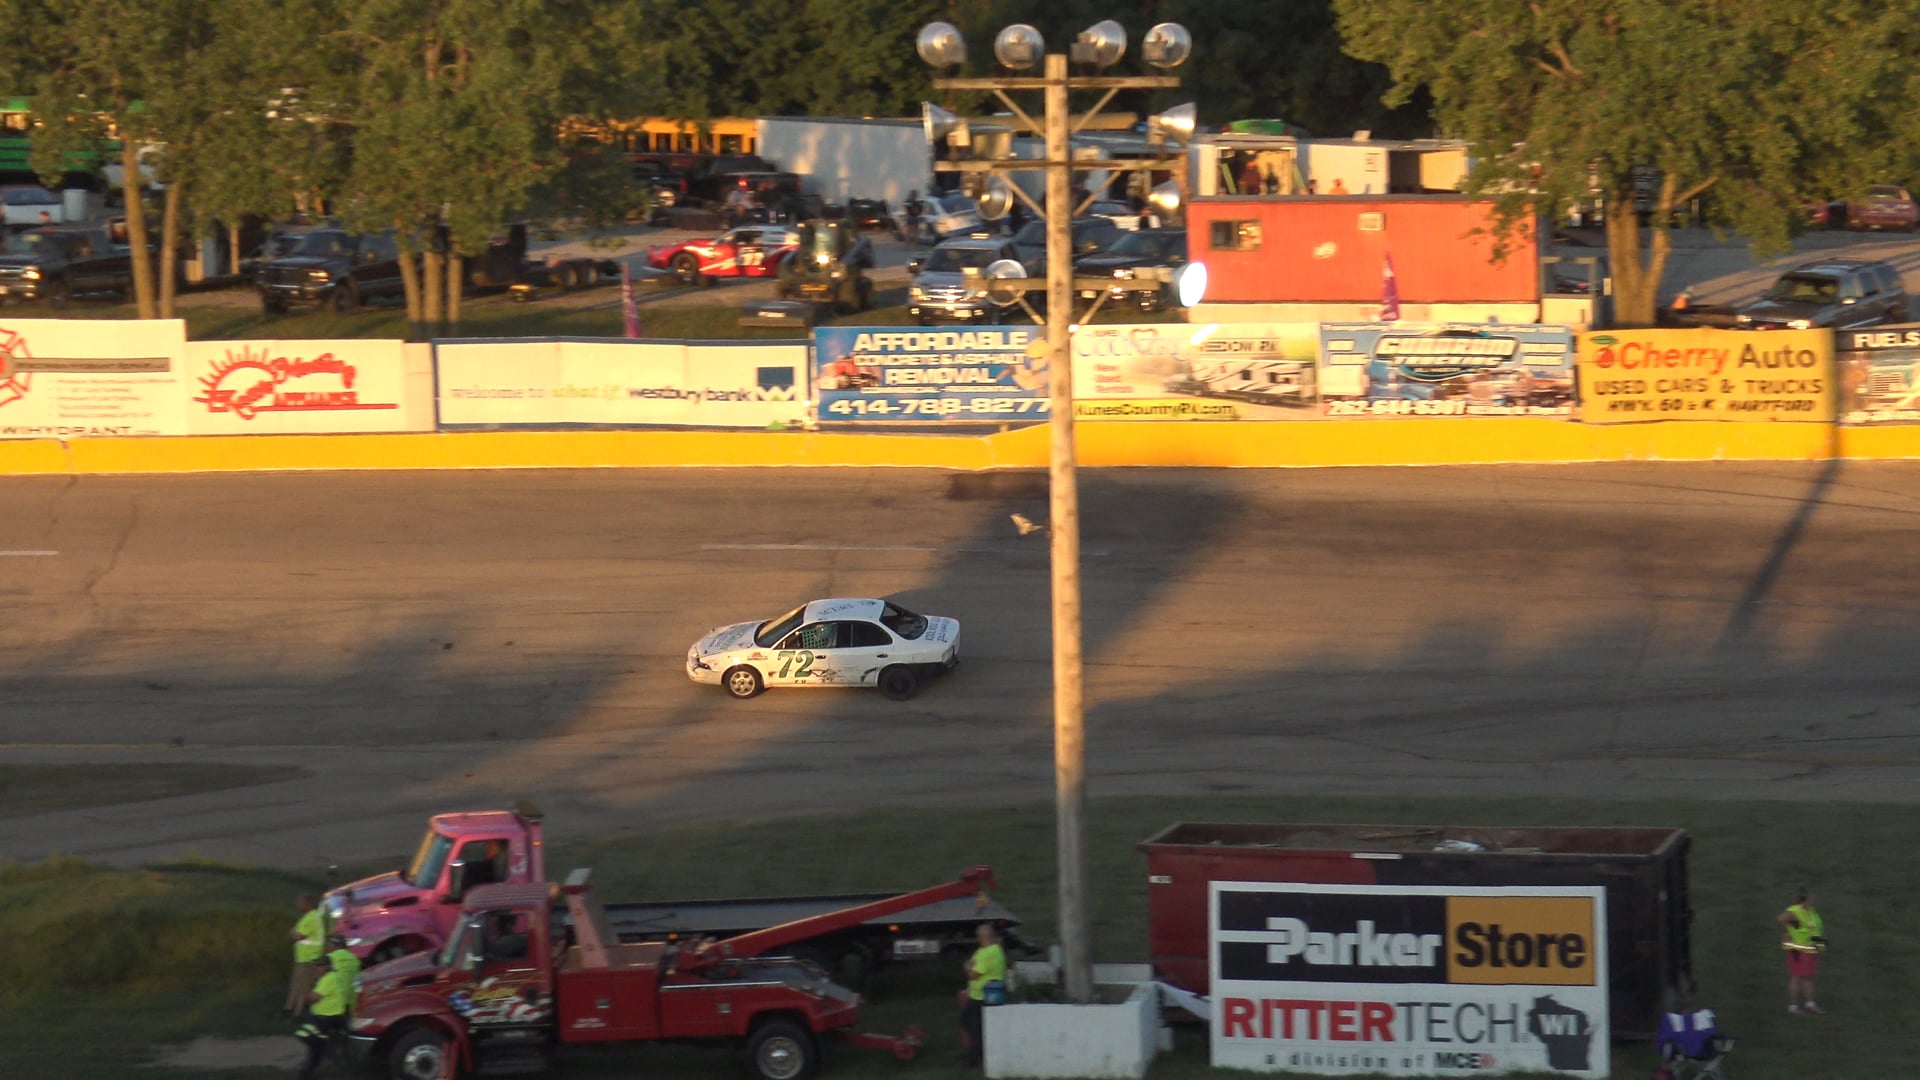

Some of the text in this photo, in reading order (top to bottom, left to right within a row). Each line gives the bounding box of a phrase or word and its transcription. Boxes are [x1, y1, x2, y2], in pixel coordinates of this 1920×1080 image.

[853, 332, 1029, 352] AFFORDABLE
[854, 354, 939, 366] CONCRETE
[954, 354, 1025, 366] ASPHALT
[1618, 341, 1817, 375] Cherry Auto
[885, 368, 997, 385] REMOVAL
[628, 385, 701, 404] westbury
[706, 386, 752, 402] bank
[1594, 378, 1823, 395] USED CARS & TRUCKS
[1659, 398, 1682, 411] 60
[1726, 399, 1816, 412] HARTFORD
[777, 650, 815, 679] 72
[1266, 916, 1585, 969] Parker Store
[1223, 997, 1520, 1043] RITTERTECH
[1539, 1013, 1577, 1035] WI
[1264, 1052, 1481, 1069] a division of MCE
